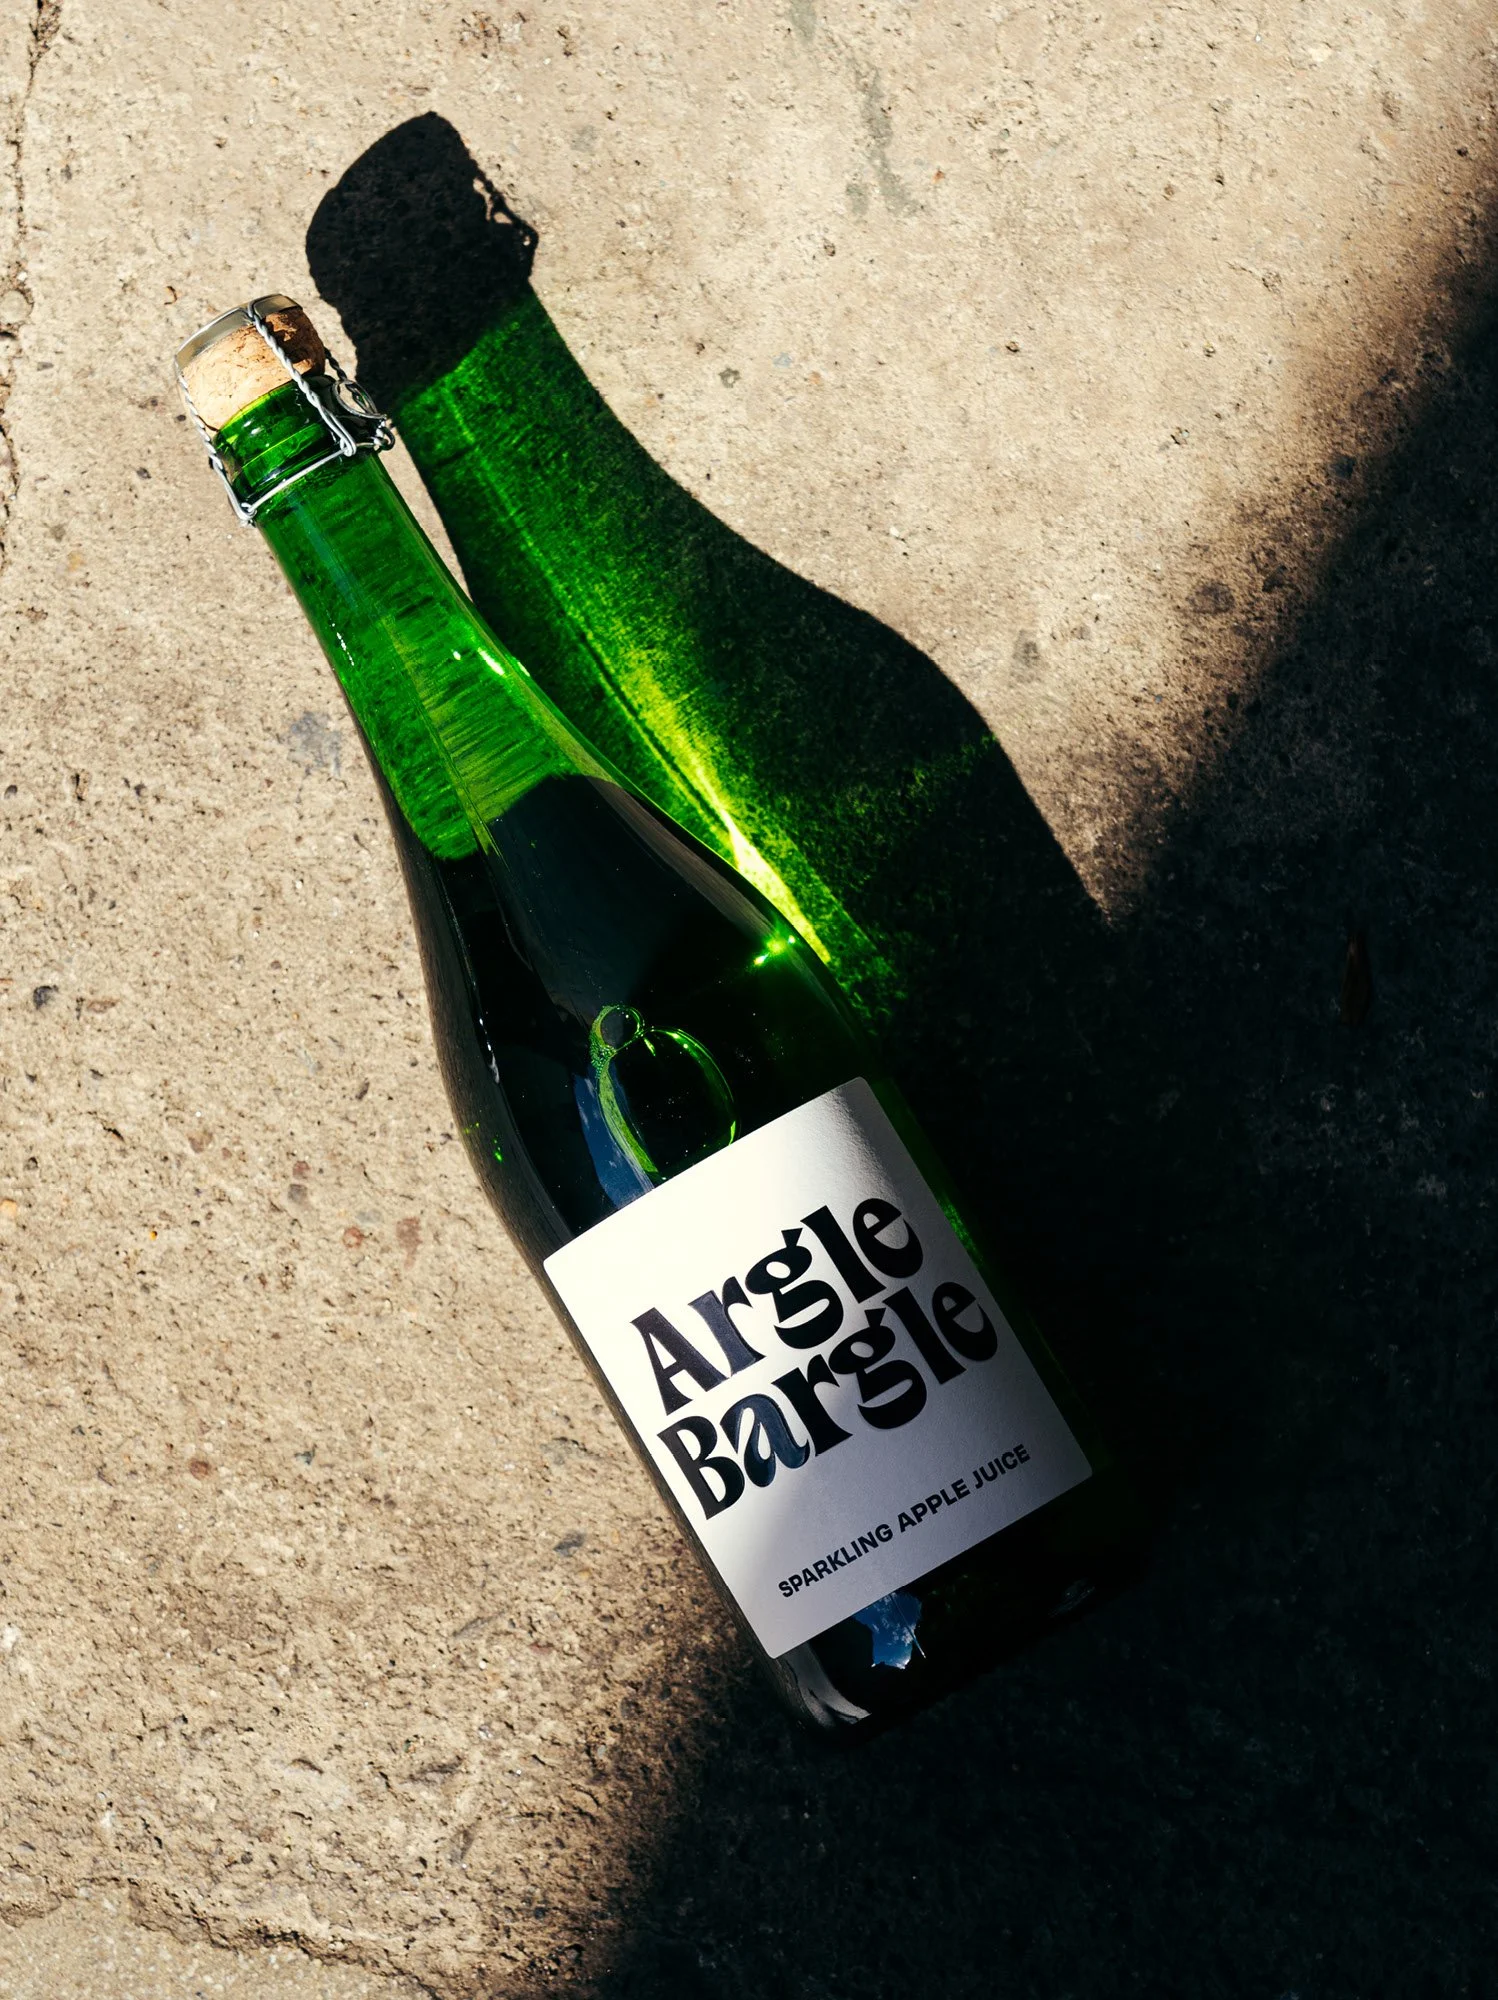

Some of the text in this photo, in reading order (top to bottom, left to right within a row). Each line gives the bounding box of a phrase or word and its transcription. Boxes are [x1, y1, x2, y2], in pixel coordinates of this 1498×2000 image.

[631, 1197, 924, 1416] Argle
[657, 1281, 999, 1520] Bargle
[778, 1443, 1031, 1598] SPARKLING APPLE JUICE
